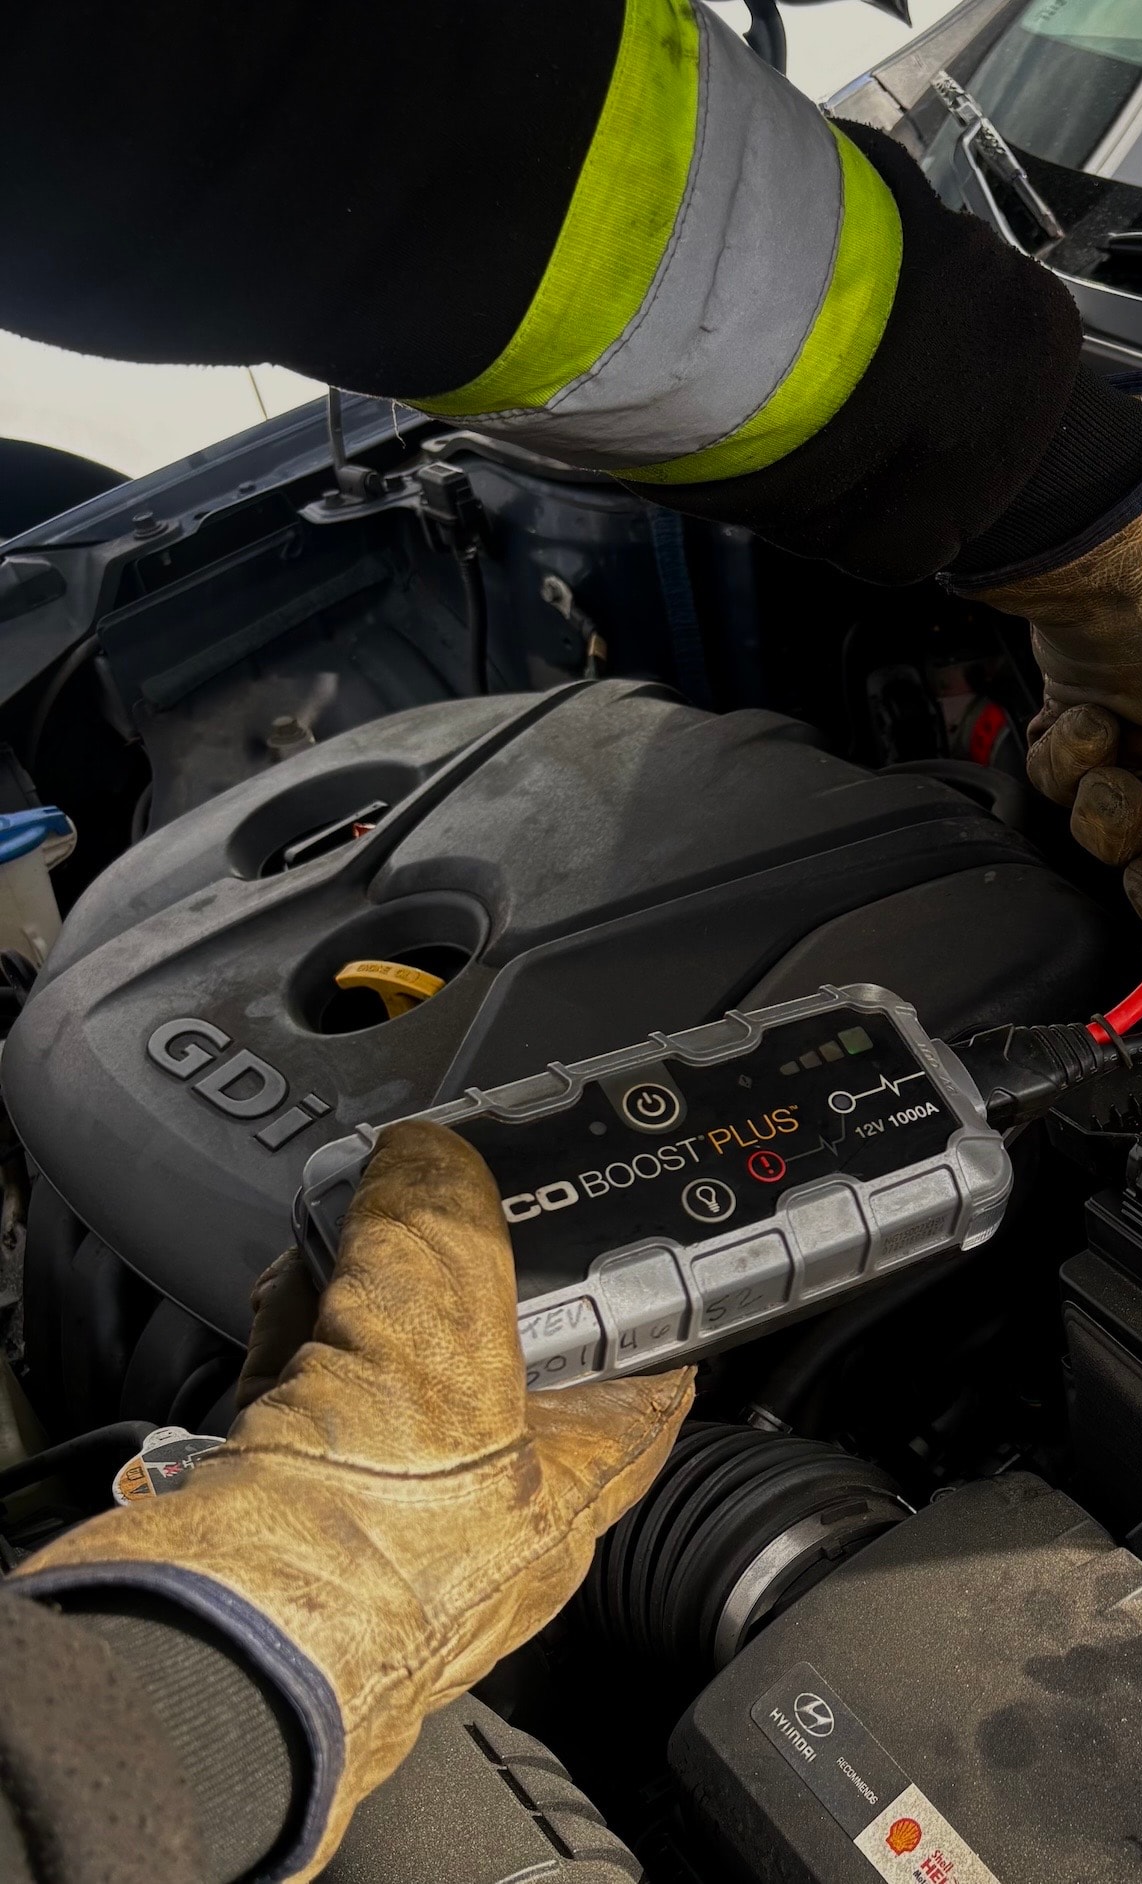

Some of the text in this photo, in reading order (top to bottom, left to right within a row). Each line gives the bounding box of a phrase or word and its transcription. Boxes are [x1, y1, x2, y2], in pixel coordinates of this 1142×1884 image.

[147, 1017, 333, 1152] GDi
[855, 1102, 940, 1138] 12V 1000A
[578, 1137, 700, 1199] BOOST
[769, 1707, 817, 1764] HYUNDAI
[836, 1755, 879, 1805] RECOMMENDS
[931, 1849, 954, 1873] Shell
